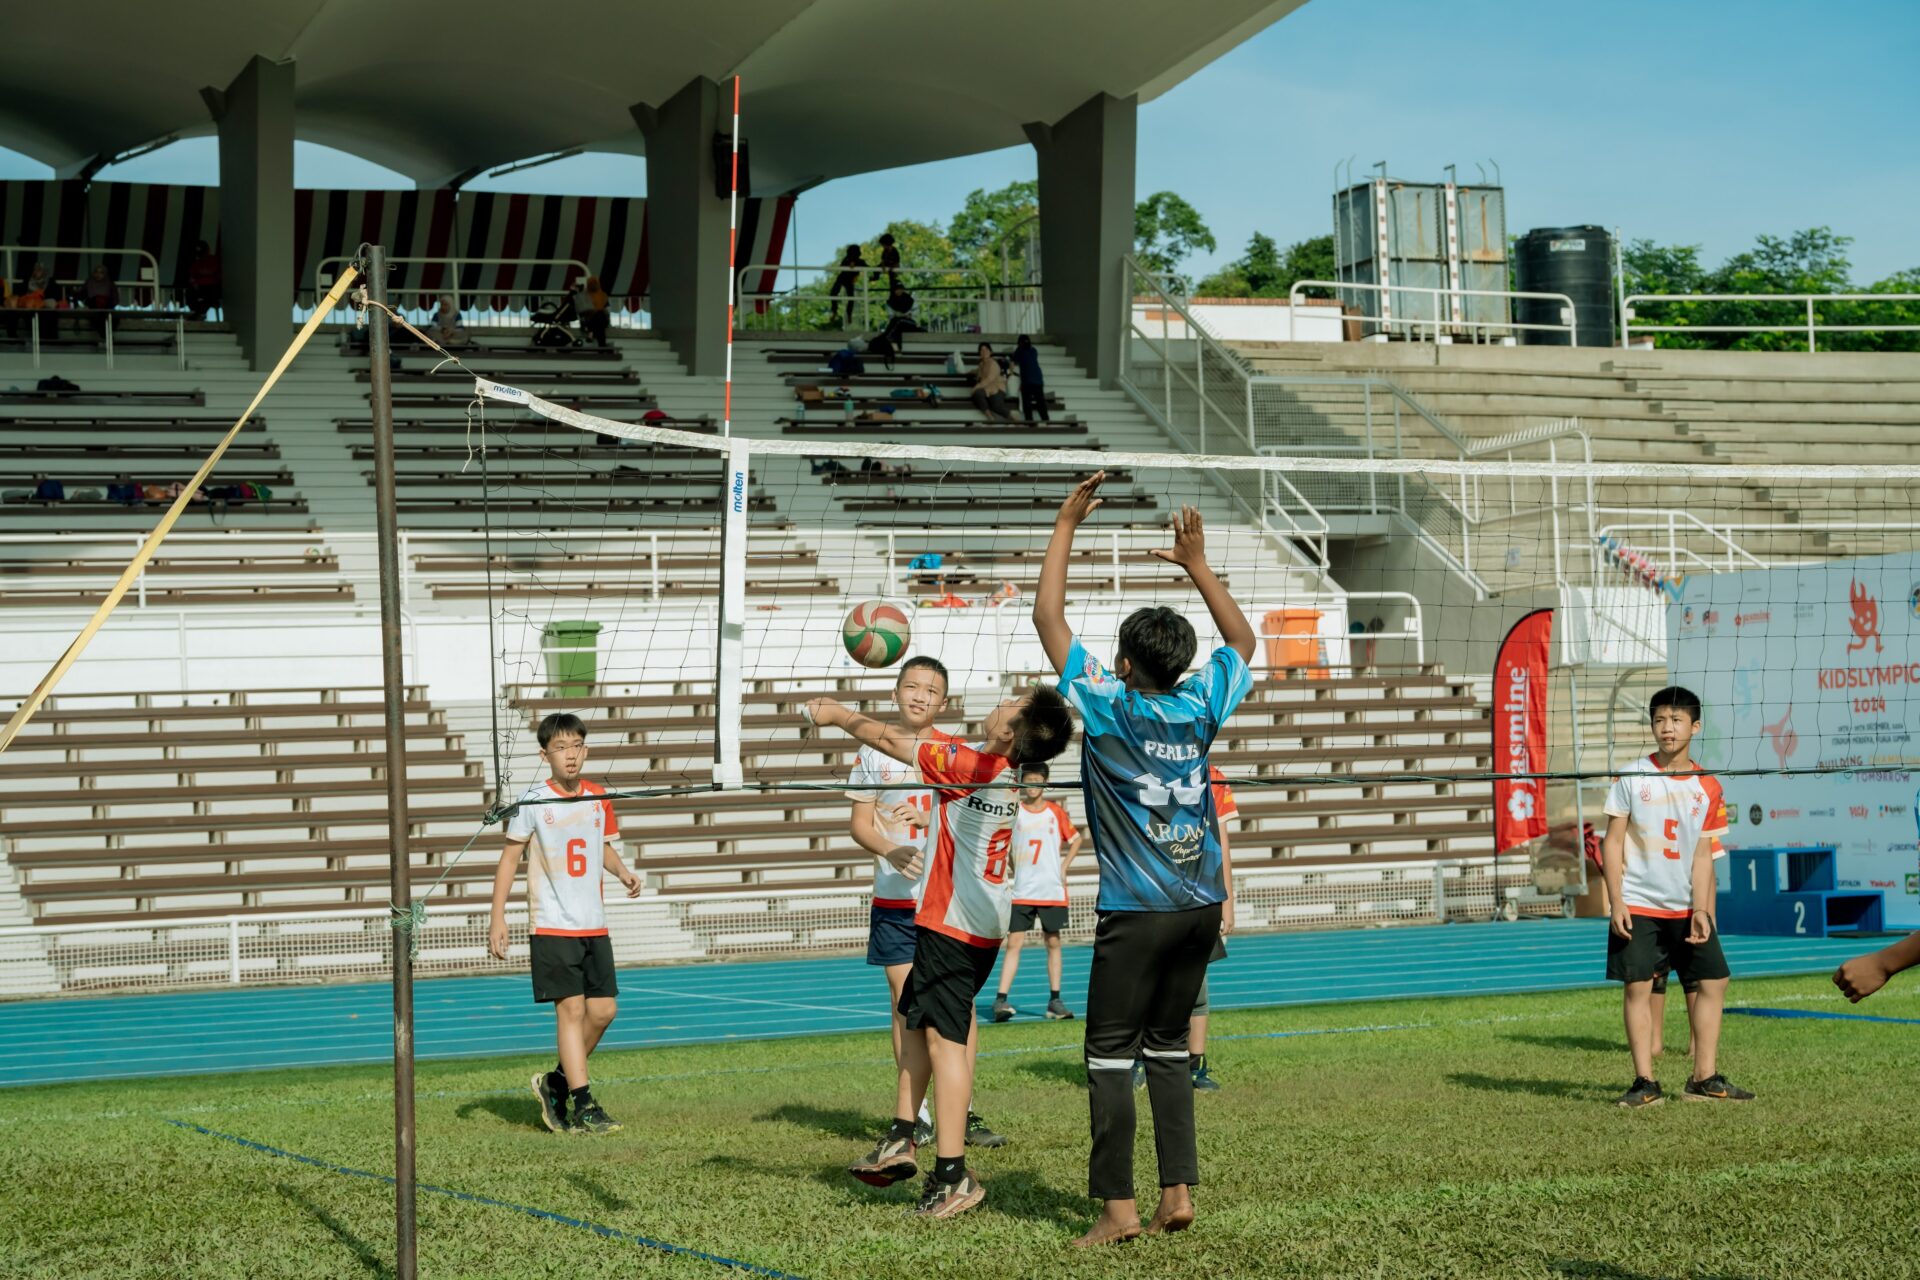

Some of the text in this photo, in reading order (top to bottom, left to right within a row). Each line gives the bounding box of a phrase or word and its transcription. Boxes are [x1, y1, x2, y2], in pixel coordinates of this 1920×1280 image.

[493, 384, 522, 397] molten
[734, 471, 744, 513] molten
[1817, 663, 1920, 689] KIDSLYMPIC
[1853, 696, 1886, 713] 2024
[1144, 740, 1200, 761] PERLIS
[967, 796, 1003, 816] Ron
[566, 838, 588, 878] 6
[1029, 839, 1042, 865] 7
[1748, 859, 1757, 891] 1
[1794, 901, 1806, 934] 2
